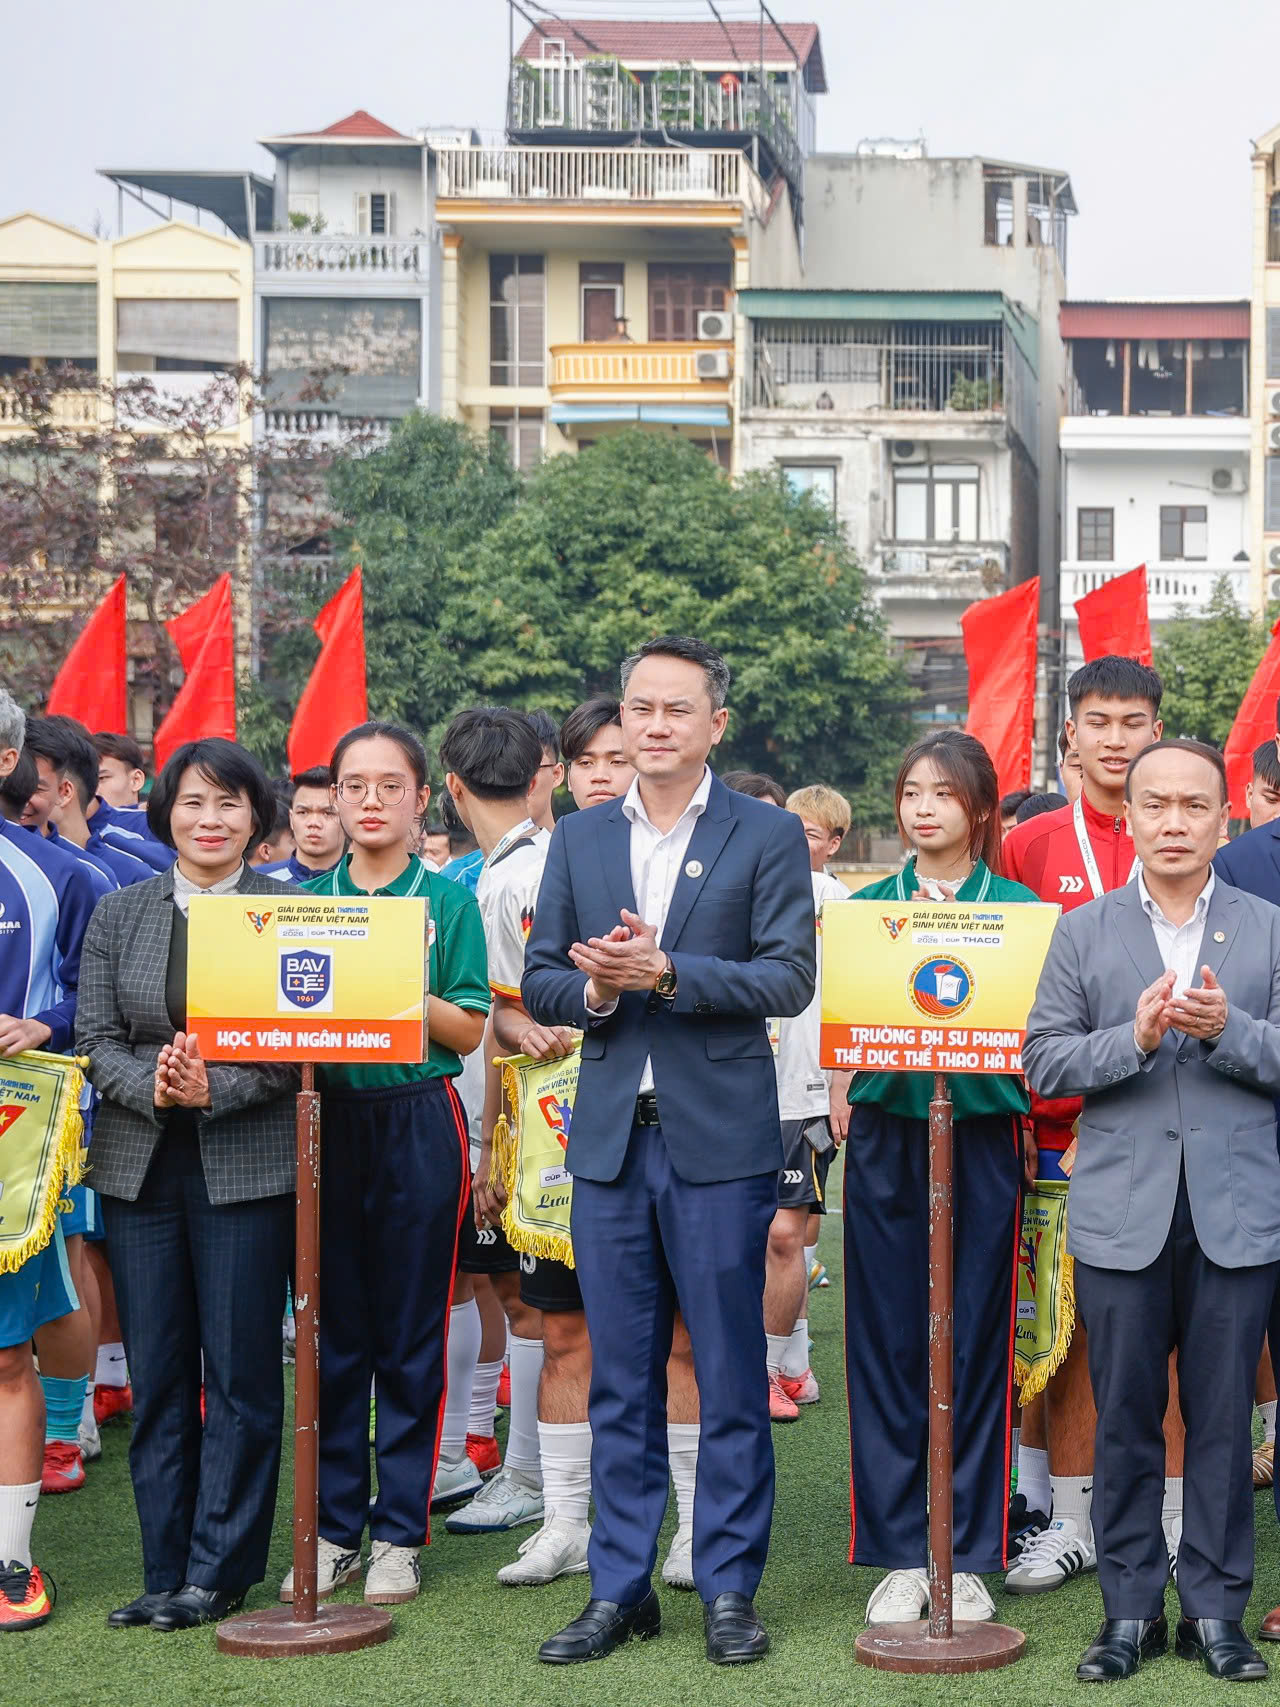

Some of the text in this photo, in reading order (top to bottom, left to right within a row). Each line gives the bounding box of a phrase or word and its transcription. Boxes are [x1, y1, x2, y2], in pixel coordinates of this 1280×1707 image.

[302, 914, 323, 922] VIÊN
[326, 916, 345, 924] VIỆT
[938, 921, 958, 929] VIÊN
[961, 922, 979, 931] VIỆT
[287, 958, 325, 972] BAV
[217, 1028, 391, 1050] HỌC VIỆN NGÂN HÀNG
[921, 1030, 943, 1045] ĐH
[834, 1044, 864, 1064] THỂ
[867, 1049, 898, 1068] DỤC
[904, 1045, 933, 1066] THỂ
[937, 1051, 979, 1068] THAO
[984, 1048, 1005, 1068] HÀ
[551, 1076, 569, 1090] VIÊN
[14, 1091, 41, 1103] NAM
[544, 1173, 561, 1182] CÚP
